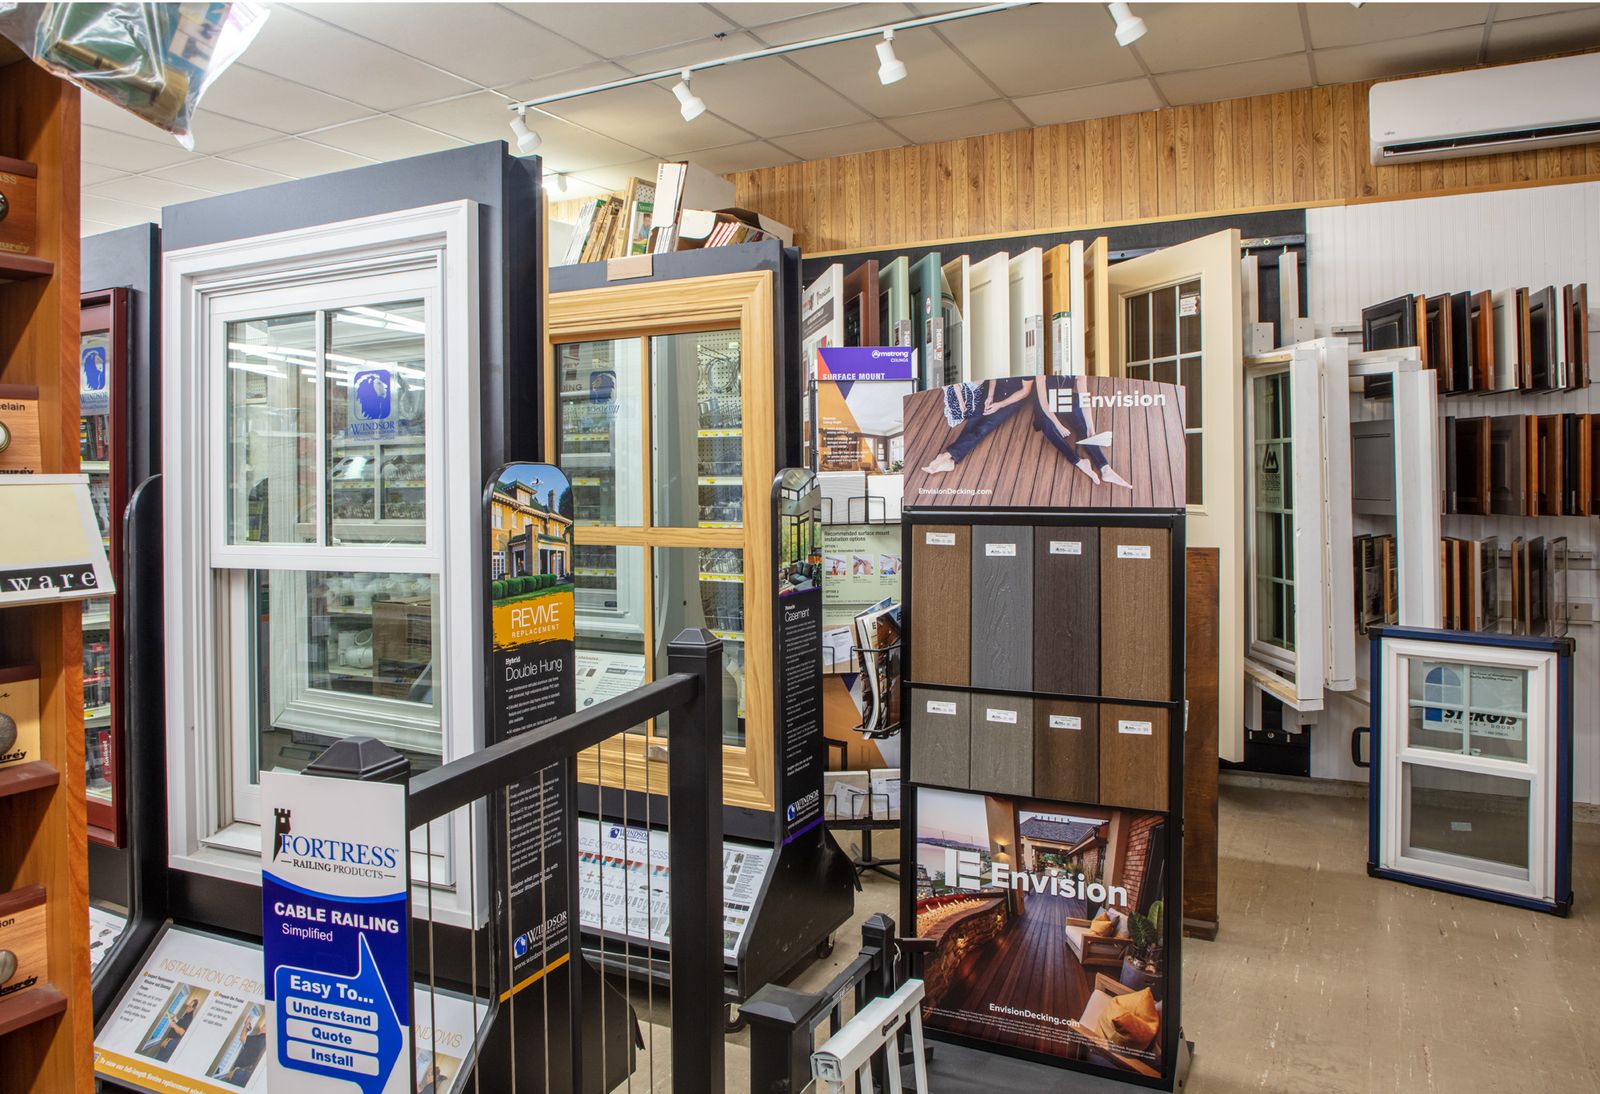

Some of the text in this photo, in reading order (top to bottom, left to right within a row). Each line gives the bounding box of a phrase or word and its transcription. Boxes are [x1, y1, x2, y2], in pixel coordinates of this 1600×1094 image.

[0, 403, 26, 411] elain
[1079, 390, 1166, 409] Envision
[918, 487, 993, 497] EnvisionDecking.com
[8, 570, 96, 592] ware
[511, 603, 559, 630] REVIVE
[785, 608, 810, 622] Casement
[511, 624, 560, 639] REPLACEMENT
[505, 661, 538, 681] Double
[539, 658, 563, 674] Hung
[280, 833, 396, 869] FORTRESS
[293, 859, 384, 880] RAILING PRODUCTS
[991, 862, 1128, 907] Envision
[274, 902, 399, 934] CABLE RAILING
[527, 910, 567, 944] WIDSOR
[282, 922, 333, 942] Simplified
[290, 974, 374, 1004] Easy To...
[292, 1001, 371, 1027] Understand
[989, 1003, 1081, 1028] EnvisionDecking.com
[311, 1027, 353, 1045] Quote
[311, 1048, 354, 1067] Install
